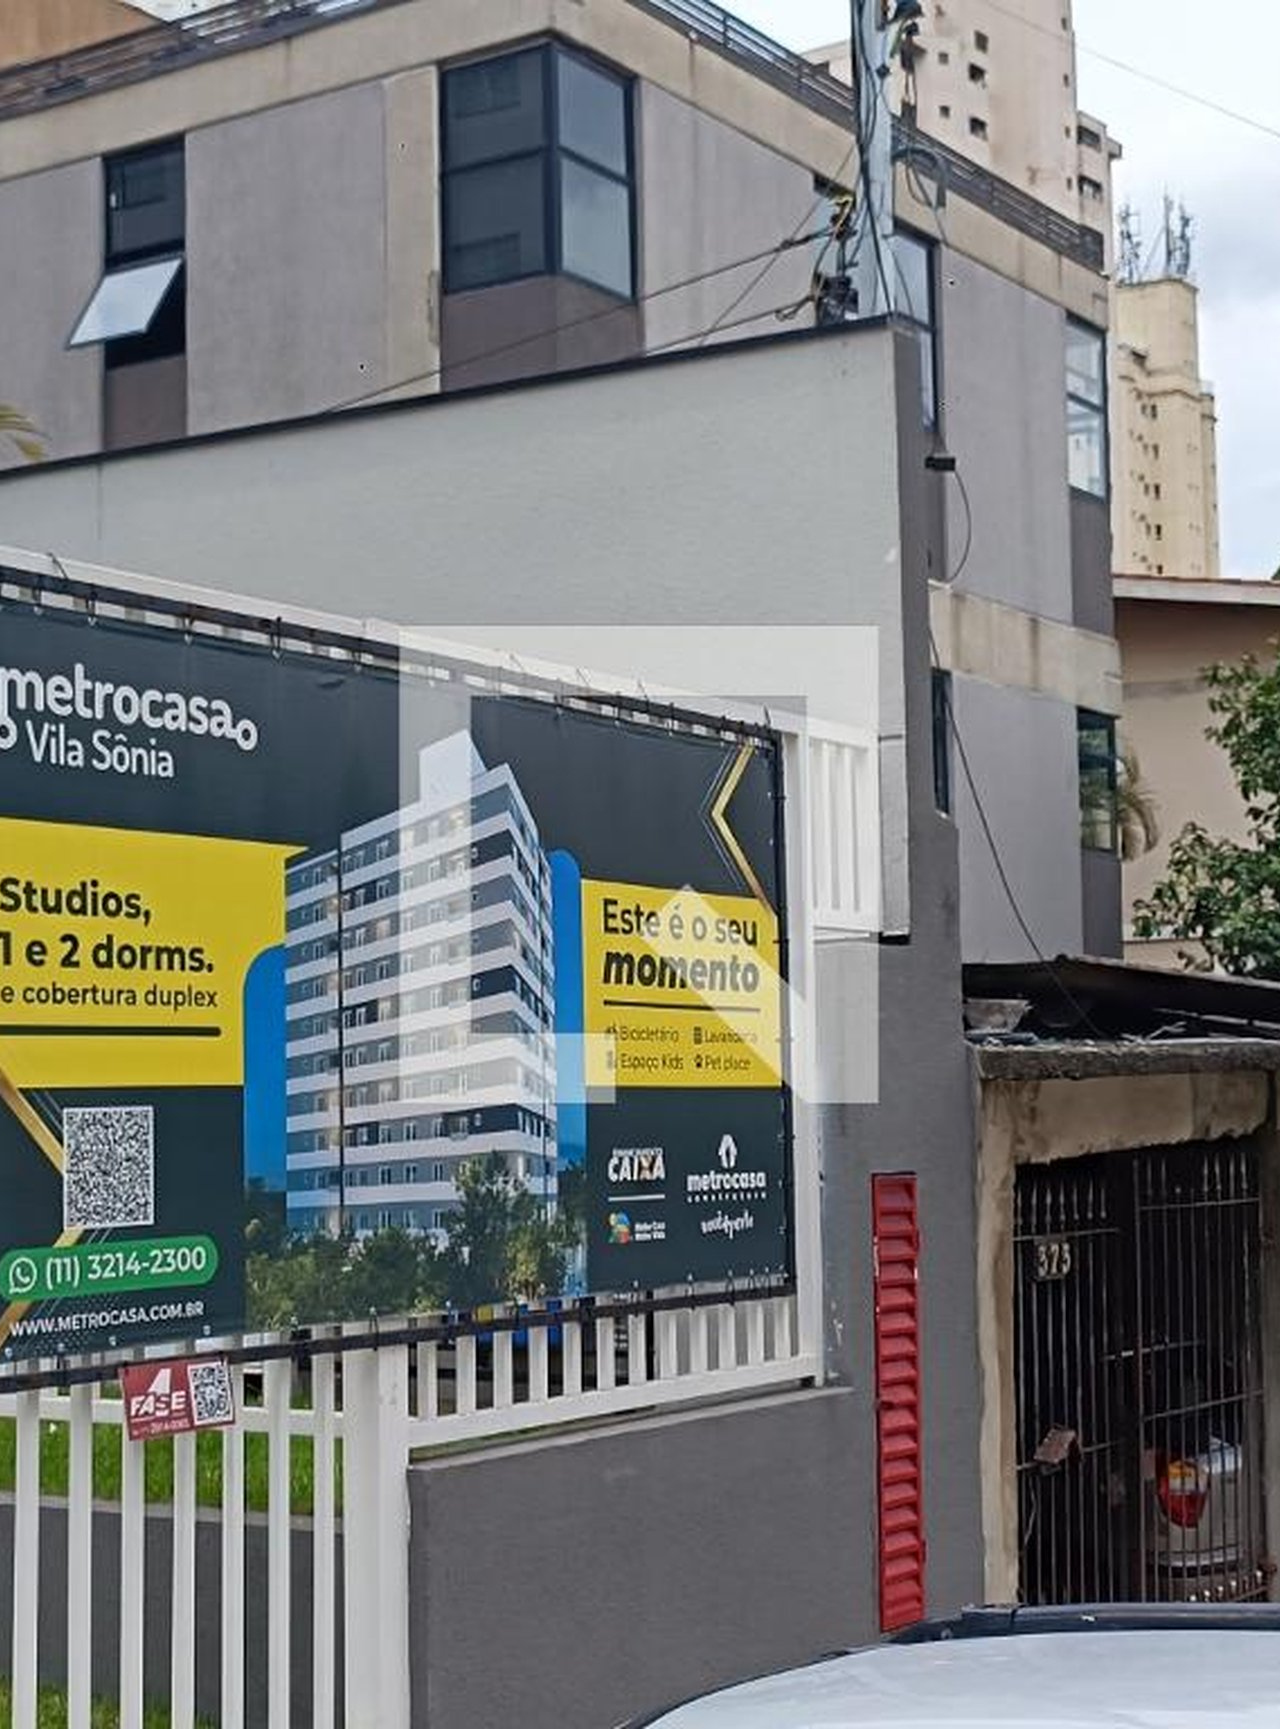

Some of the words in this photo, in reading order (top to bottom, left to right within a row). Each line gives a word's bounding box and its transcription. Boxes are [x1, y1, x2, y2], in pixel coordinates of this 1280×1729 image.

[25, 720, 85, 769] Vila
[92, 729, 175, 778] Sônia
[603, 897, 661, 937] Este
[669, 903, 684, 941] é
[692, 915, 708, 942] o
[715, 917, 758, 947] seu
[25, 939, 48, 968] e
[59, 933, 81, 969] 2
[92, 934, 214, 974] dorms.
[603, 950, 760, 993] momento
[0, 985, 15, 1004] e
[22, 980, 138, 1007] cobertura
[144, 983, 219, 1013] duplex
[608, 1154, 666, 1183] CAIXA
[687, 1170, 767, 1192] metrocasa
[45, 1255, 81, 1291] (11)
[87, 1245, 207, 1281] 3214-2300
[1038, 1243, 1071, 1277] 373
[8, 1300, 205, 1338] WWW.METROCASA.COM.BR
[130, 1390, 187, 1418] FASE
